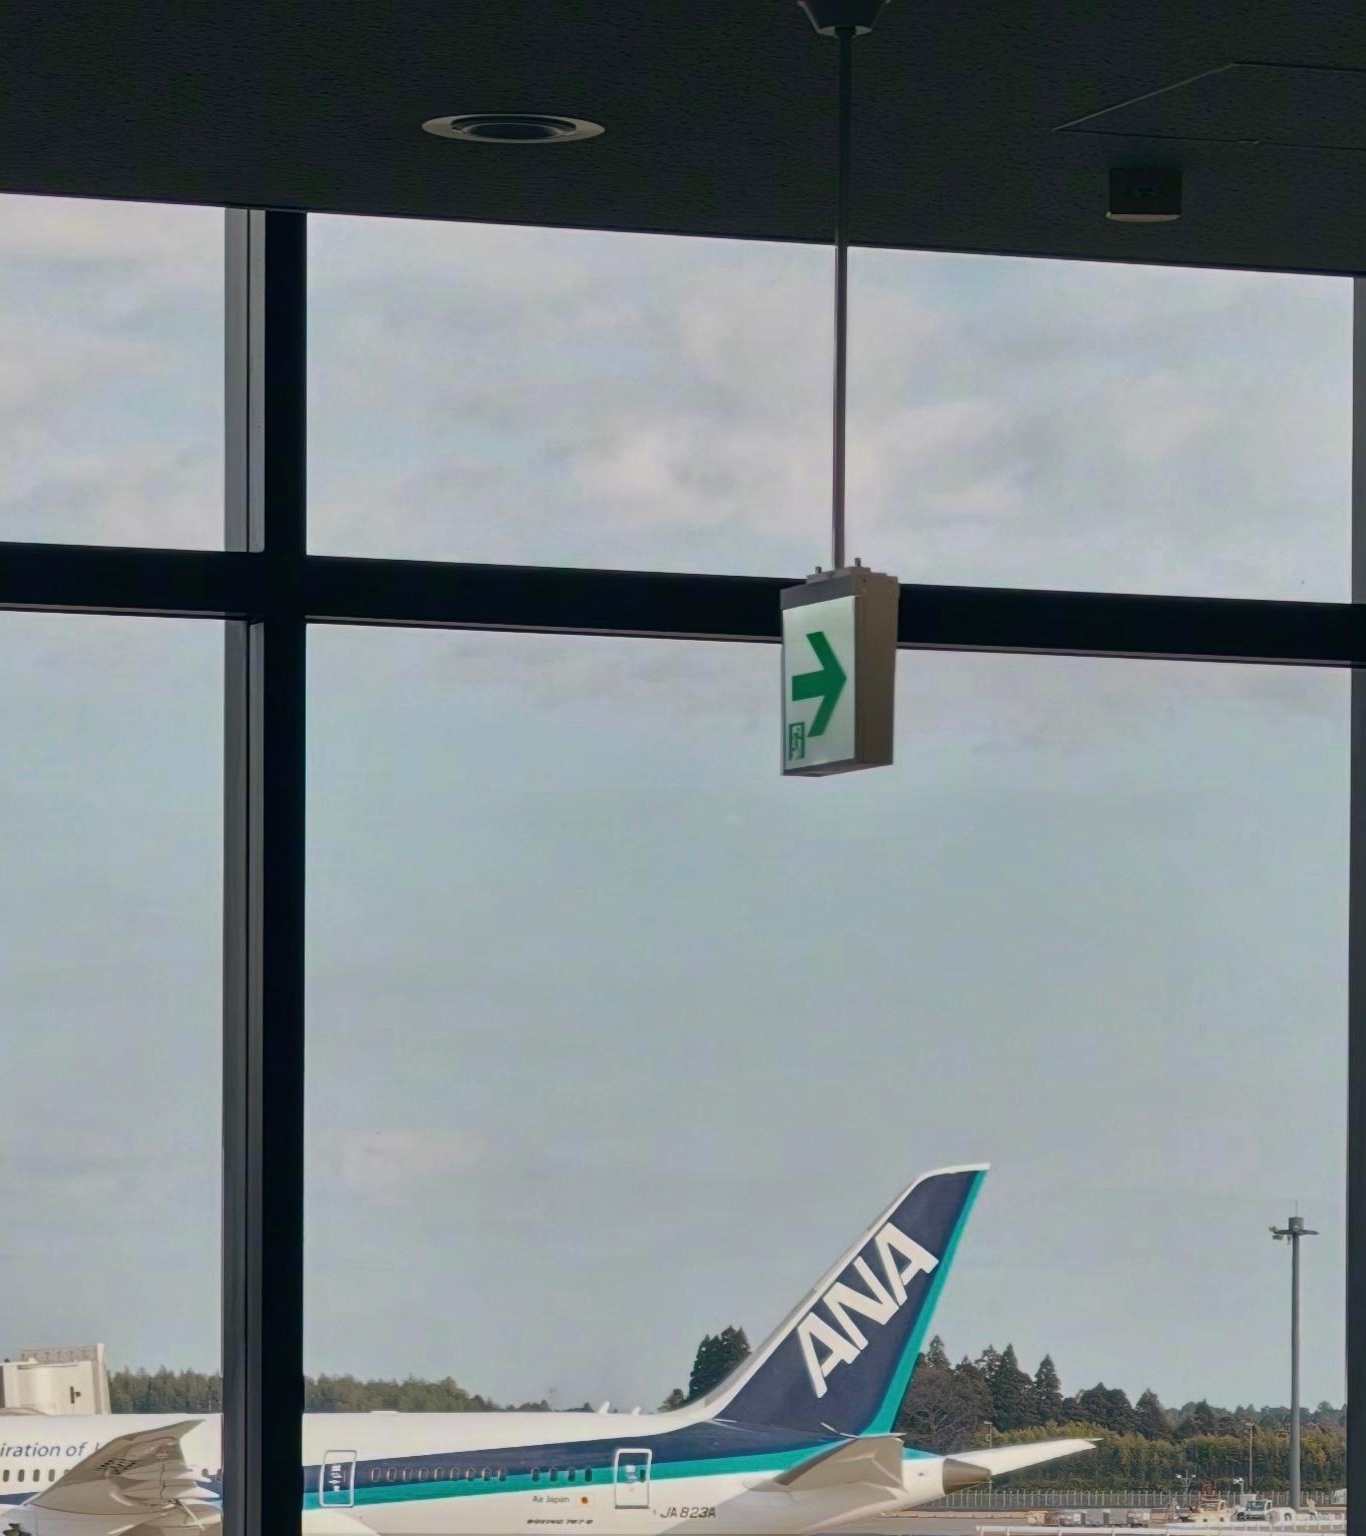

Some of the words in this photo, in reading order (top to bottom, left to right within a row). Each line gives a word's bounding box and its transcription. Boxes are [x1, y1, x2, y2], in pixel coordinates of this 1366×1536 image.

[797, 1222, 939, 1398] ANA
[65, 1441, 89, 1458] of
[660, 1506, 716, 1519] JA823A
